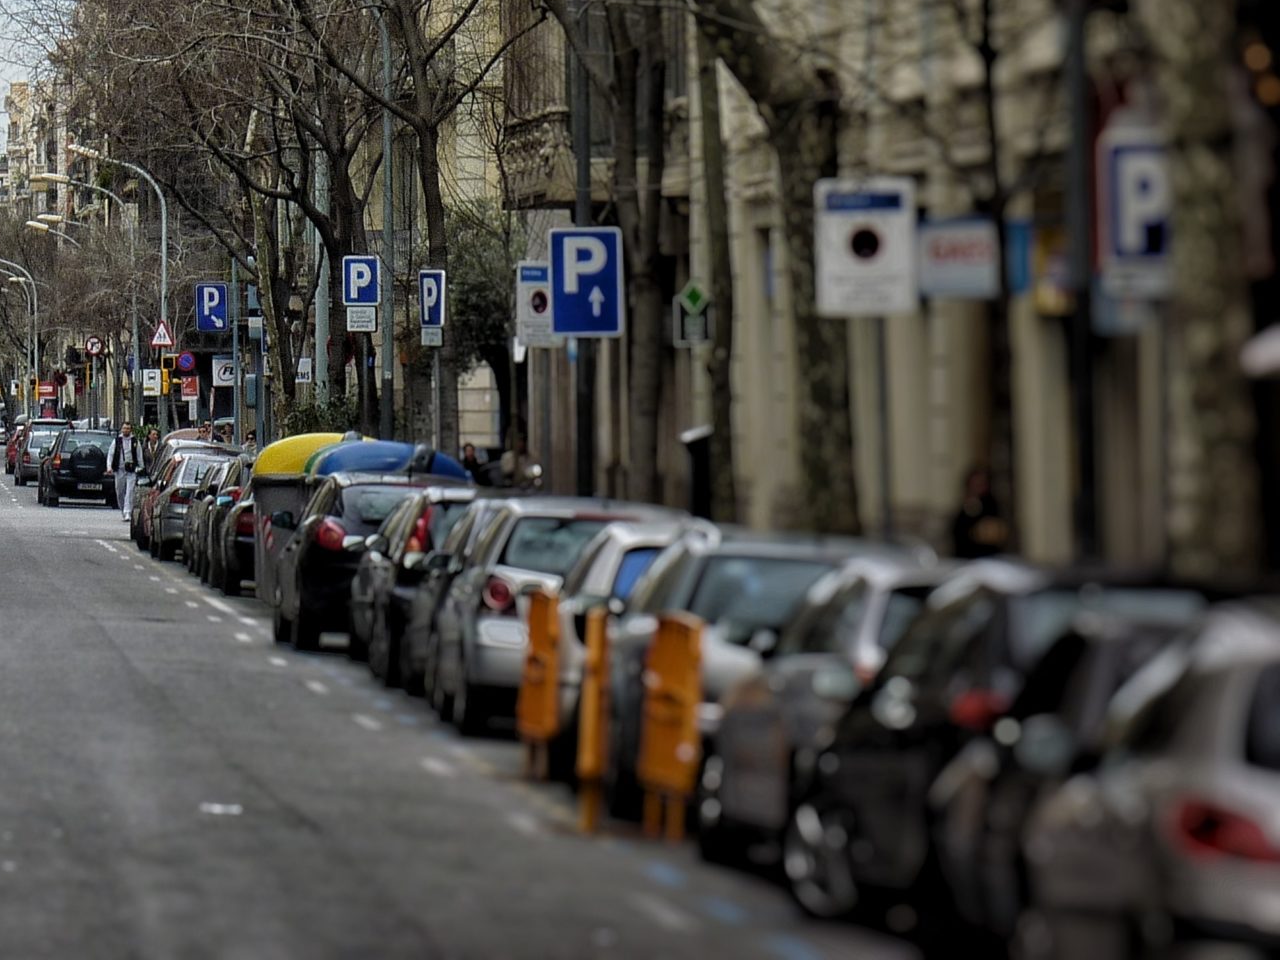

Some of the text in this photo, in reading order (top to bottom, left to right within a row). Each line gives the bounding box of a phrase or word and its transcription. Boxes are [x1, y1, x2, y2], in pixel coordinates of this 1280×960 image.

[1121, 153, 1170, 253] P
[350, 263, 372, 299] P
[563, 236, 608, 294] P
[203, 287, 220, 316] P
[423, 278, 438, 321] P
